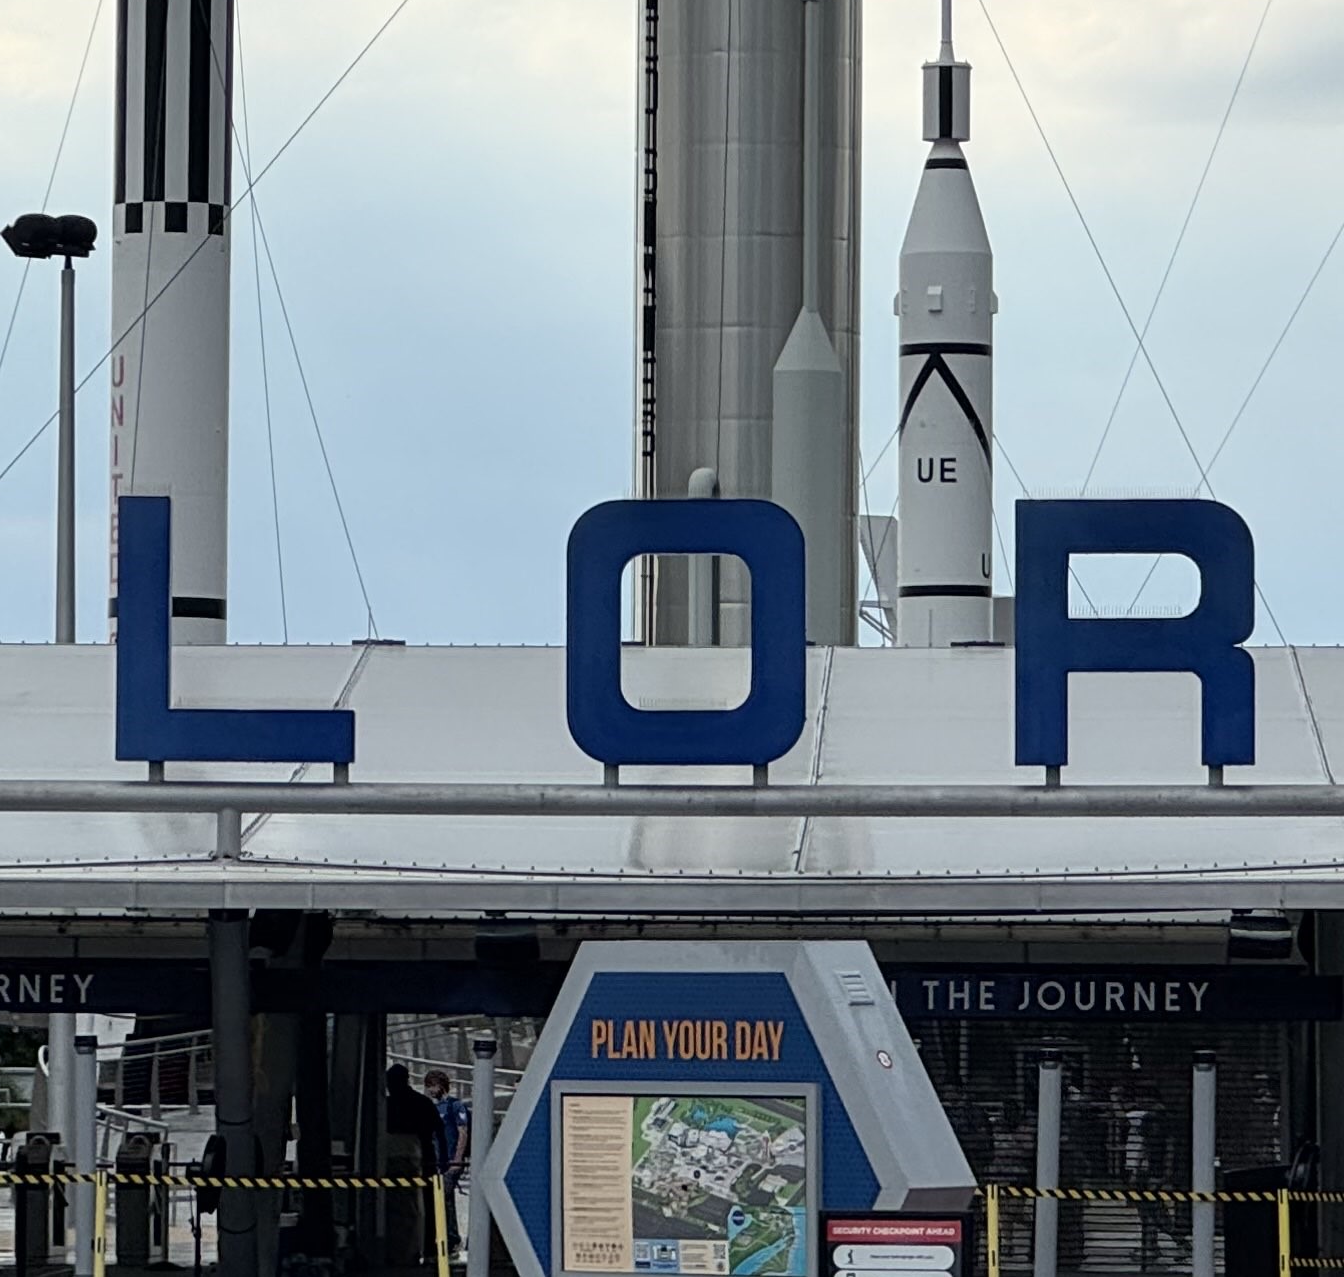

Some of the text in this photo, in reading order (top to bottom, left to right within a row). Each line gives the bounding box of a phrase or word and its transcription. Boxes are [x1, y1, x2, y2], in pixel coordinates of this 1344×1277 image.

[917, 458, 958, 483] UE
[922, 980, 996, 1010] THE
[1018, 981, 1209, 1012] JOURNEY
[591, 1020, 784, 1060] PLAN YOUR DAY
[832, 1227, 955, 1236] SECURITY CHECKPOINT AHEAD
